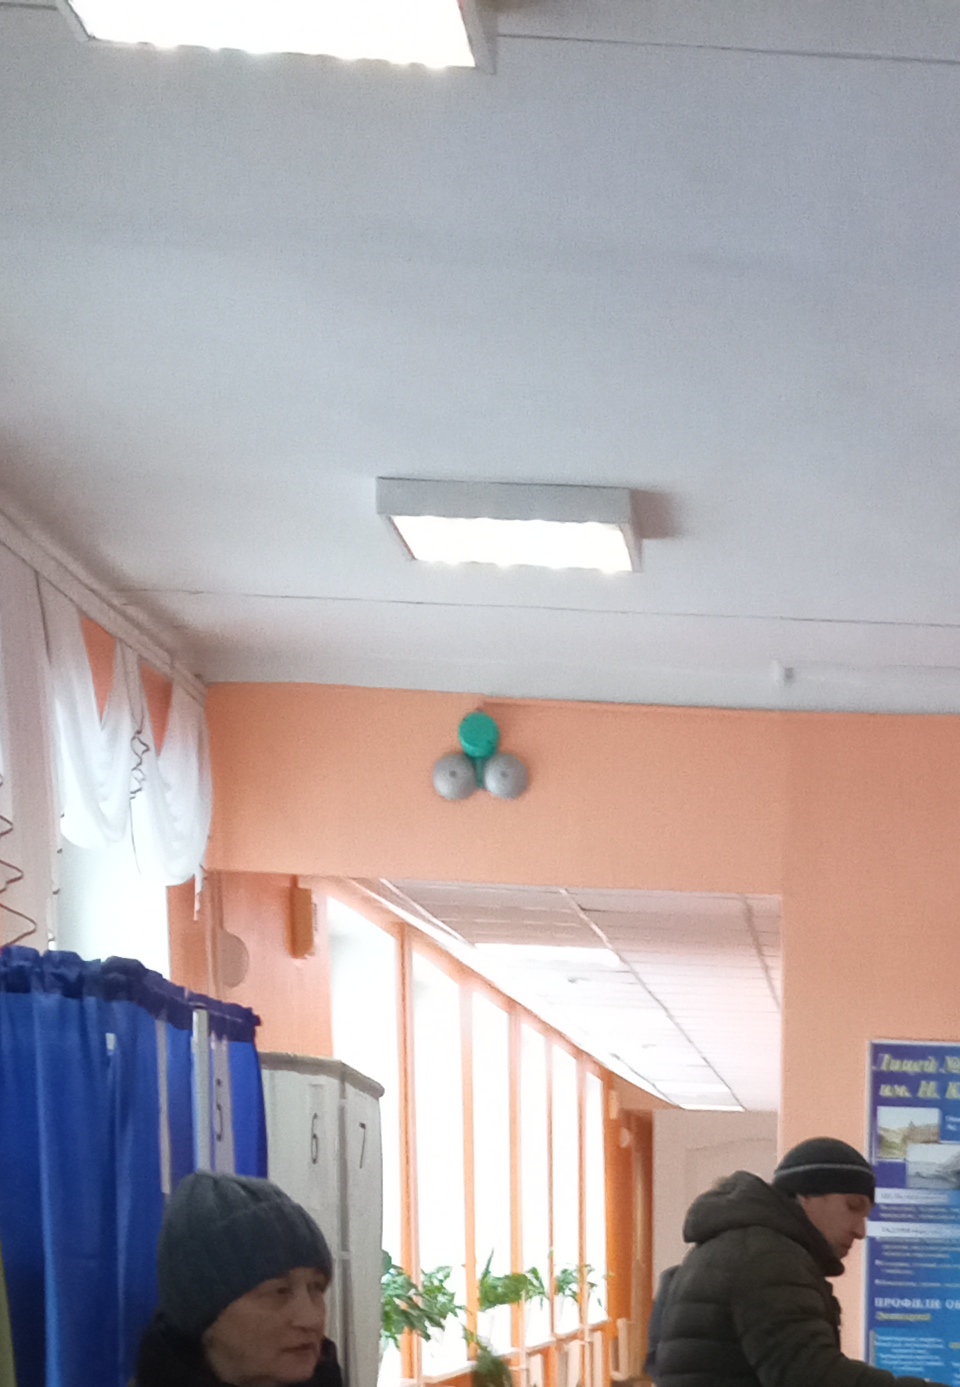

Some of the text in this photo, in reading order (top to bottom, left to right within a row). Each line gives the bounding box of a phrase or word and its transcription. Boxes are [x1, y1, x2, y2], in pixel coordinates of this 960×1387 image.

[311, 1112, 320, 1166] 6
[358, 1121, 368, 1170] 7
[874, 1297, 942, 1310] ПРОФИЛИ
